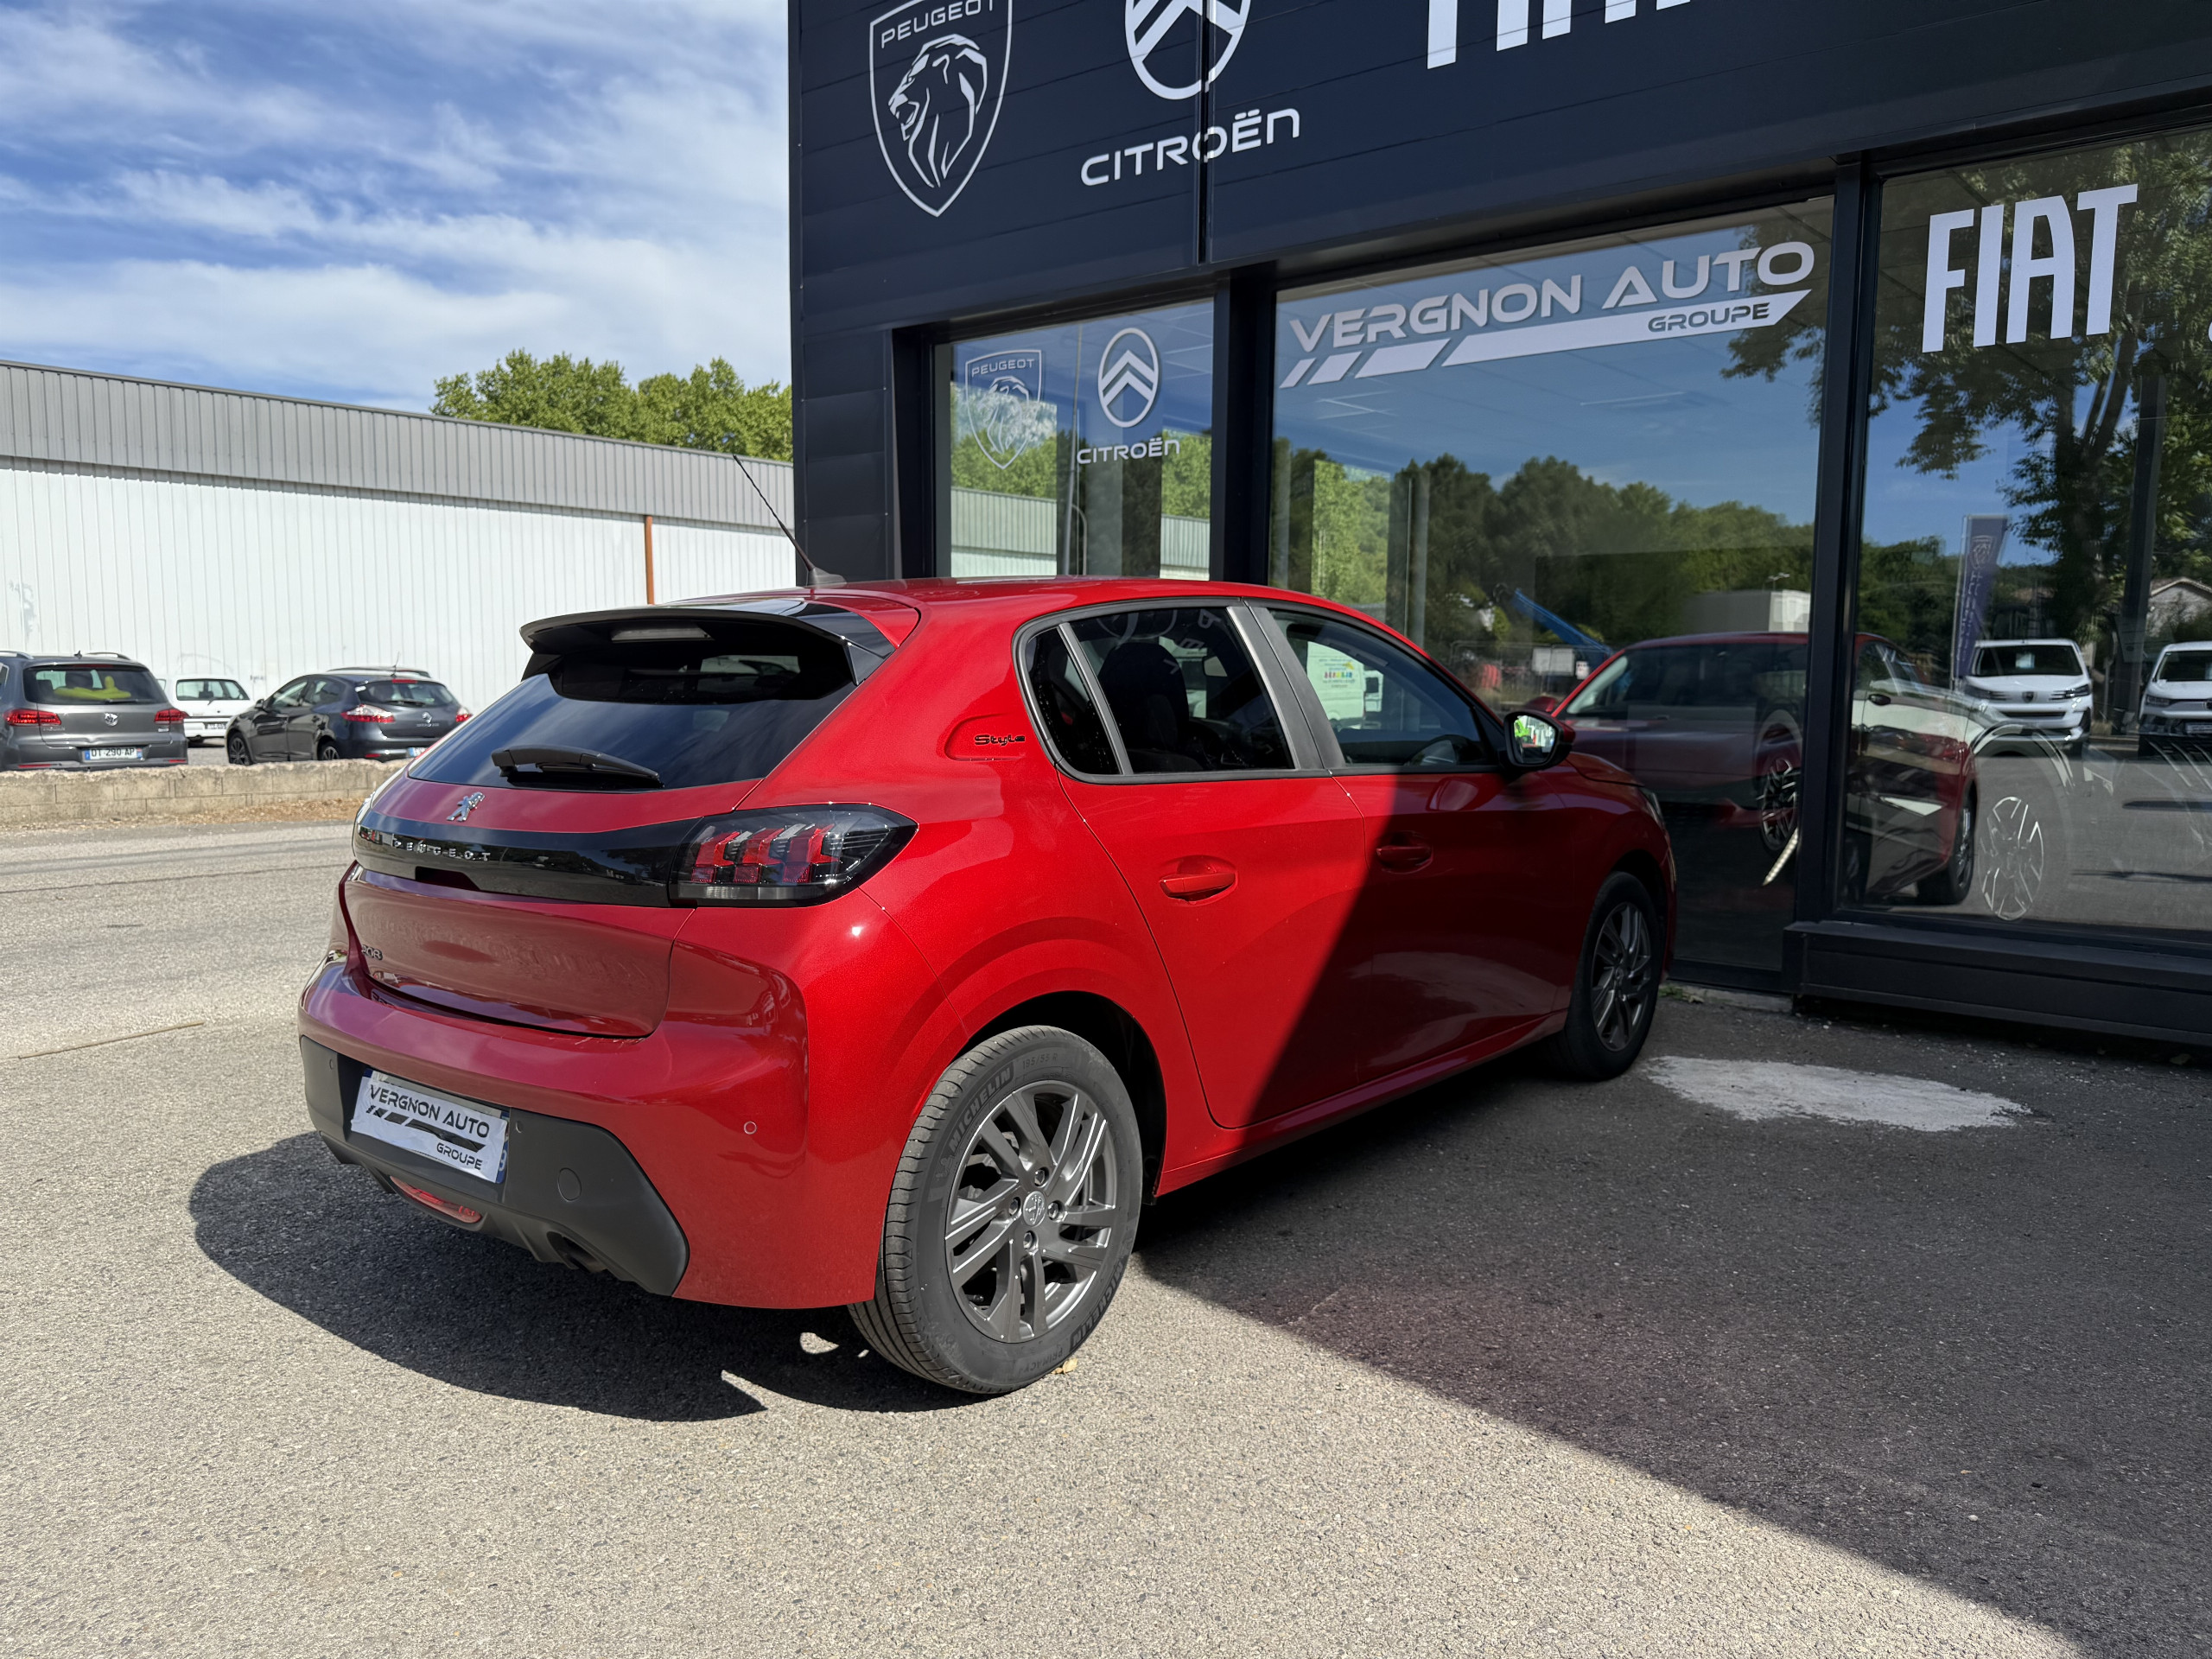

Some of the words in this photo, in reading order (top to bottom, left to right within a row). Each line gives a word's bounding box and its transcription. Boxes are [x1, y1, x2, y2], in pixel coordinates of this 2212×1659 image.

[1080, 108, 1300, 187] CITROËN
[1922, 183, 2139, 353] FIAT
[1289, 274, 1582, 353] VERGNON
[1601, 241, 1815, 310] AUTO
[1648, 302, 1770, 333] GROUPE
[970, 358, 1036, 378] PEUGEOT
[1077, 436, 1180, 465] CITROËN
[974, 734, 1026, 747] Style
[393, 838, 491, 861] PEUGEOT
[370, 1084, 440, 1121] VERGNON
[442, 1110, 490, 1138] AUTO
[949, 1067, 1011, 1153] MICHELIN
[436, 1142, 483, 1170] GROUPE
[1071, 1261, 1124, 1347] MICHELIN
